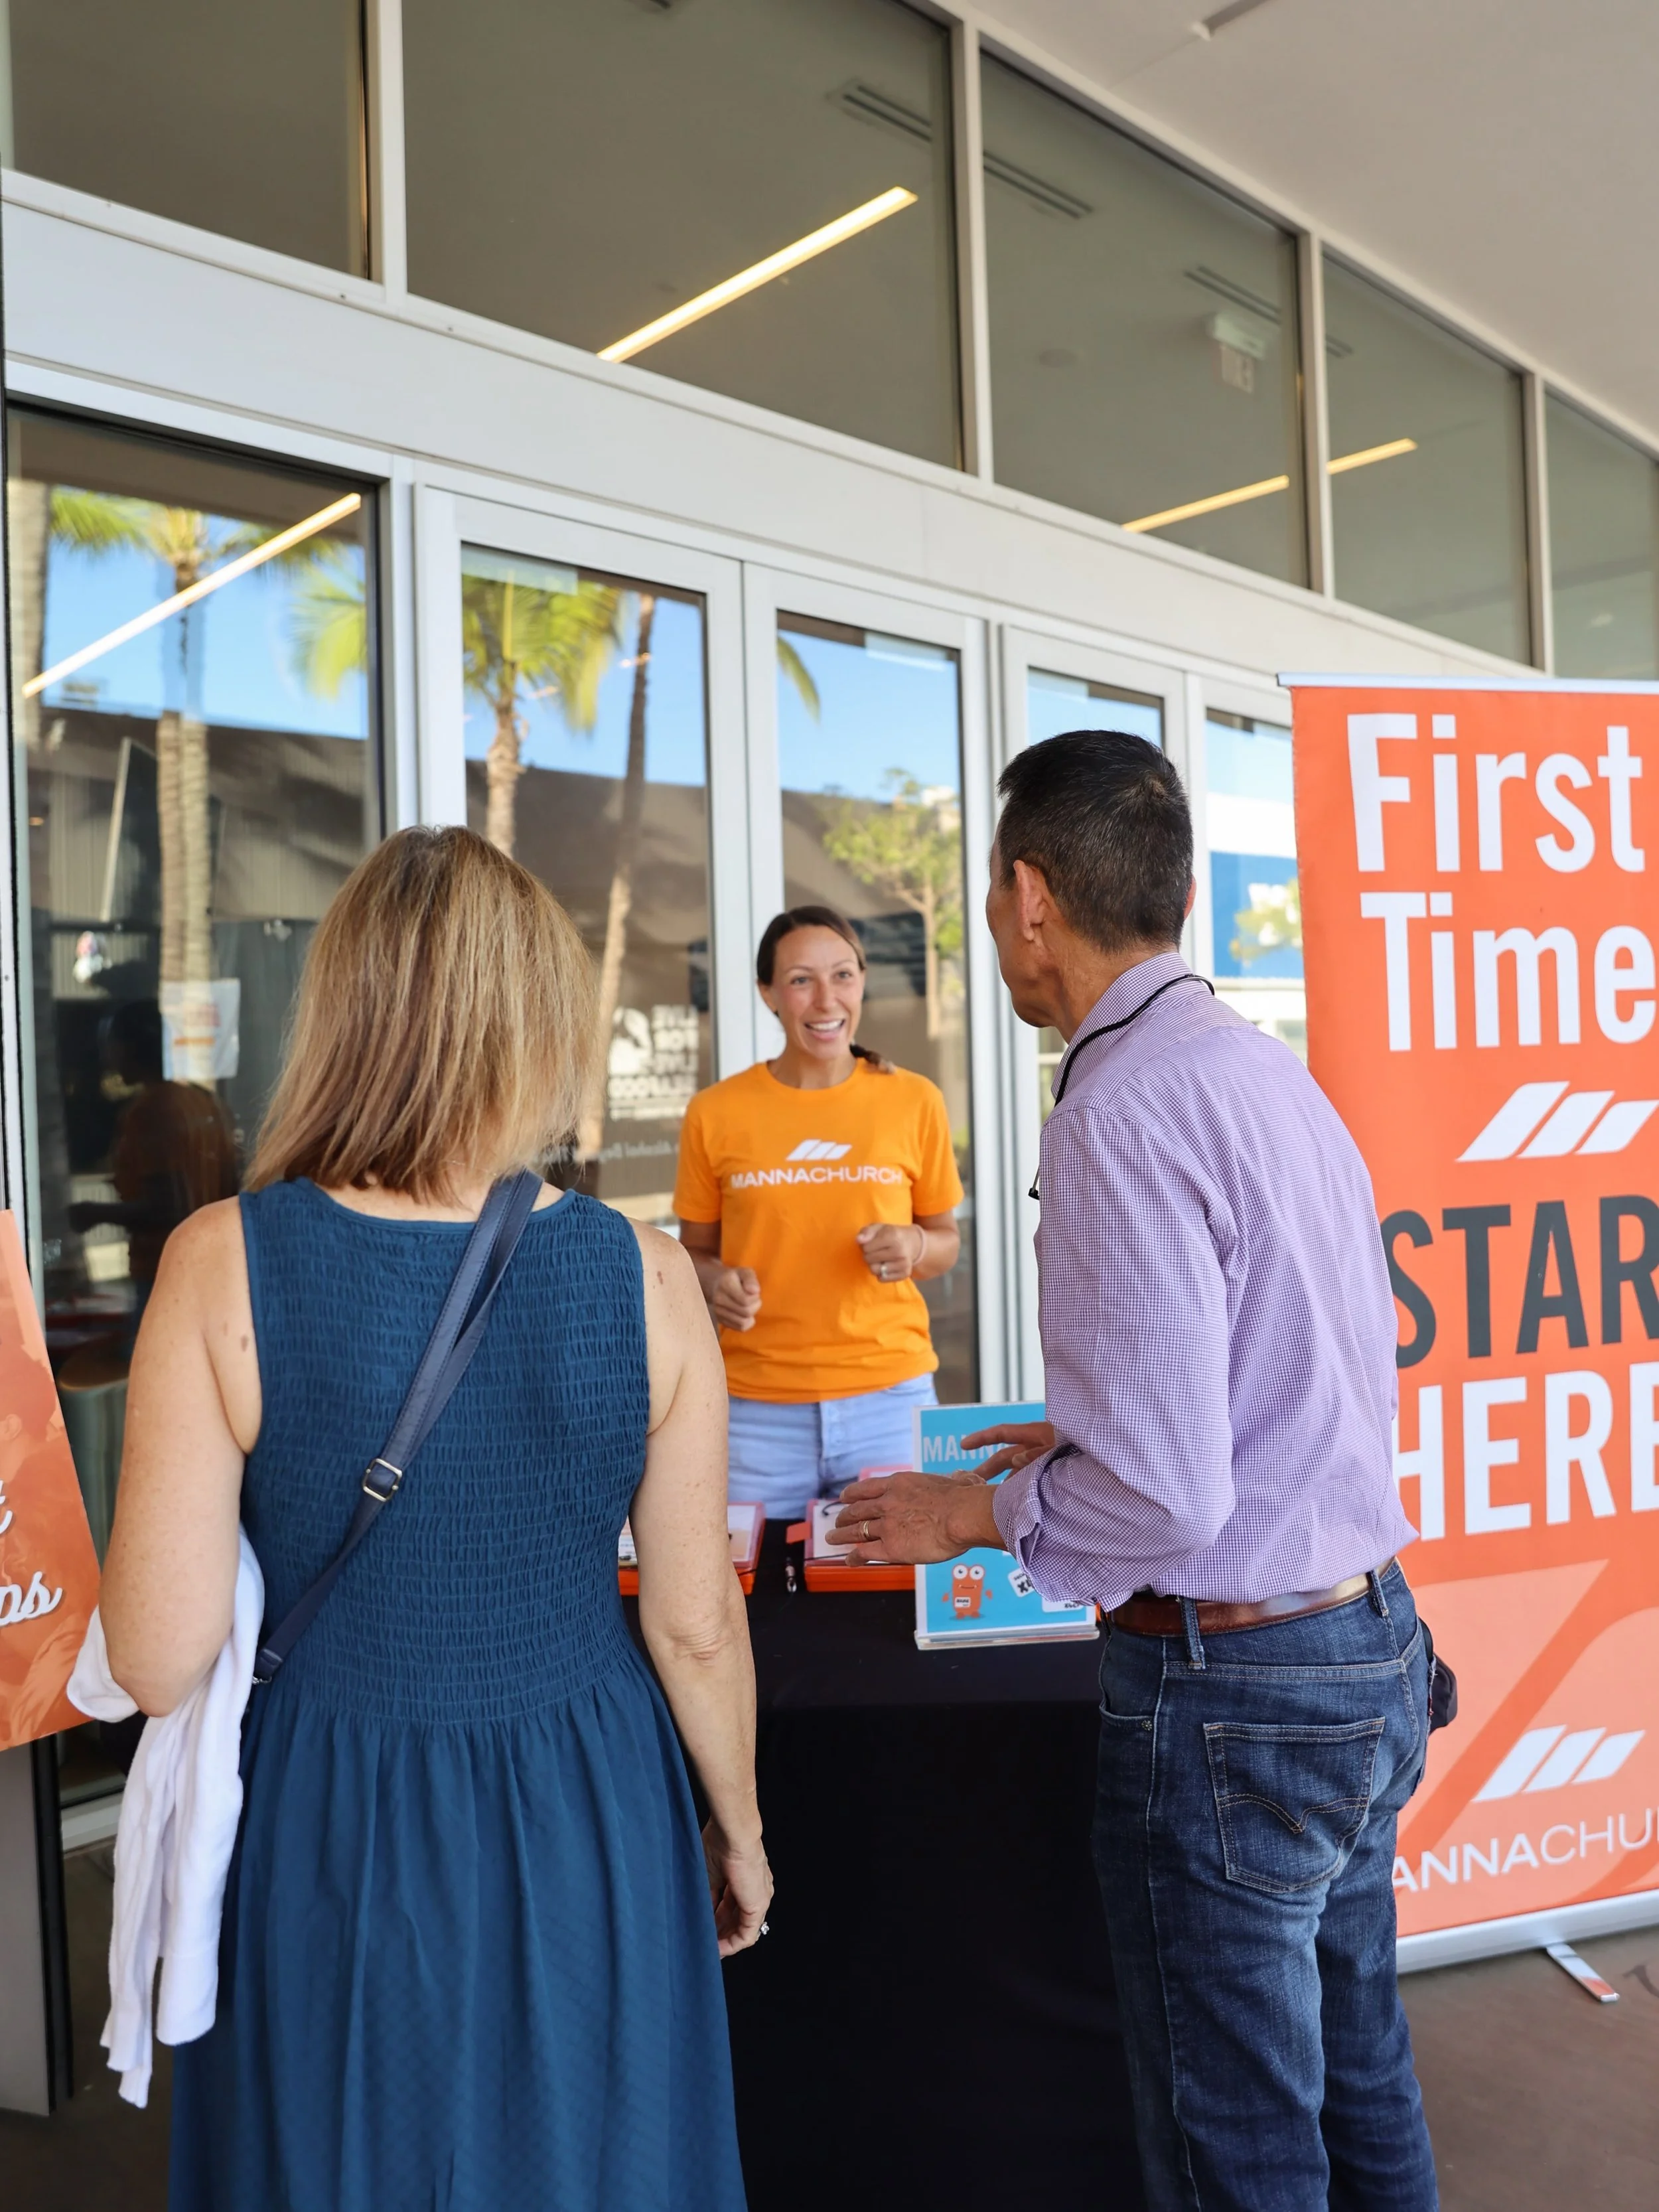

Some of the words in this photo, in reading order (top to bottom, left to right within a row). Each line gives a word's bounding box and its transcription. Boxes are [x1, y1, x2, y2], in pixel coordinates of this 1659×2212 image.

[1347, 713, 1645, 873] First
[1360, 891, 1656, 1052] Time
[731, 1165, 902, 1189] MANNACHURCH
[1392, 1805, 1659, 1893] ANNACHU
